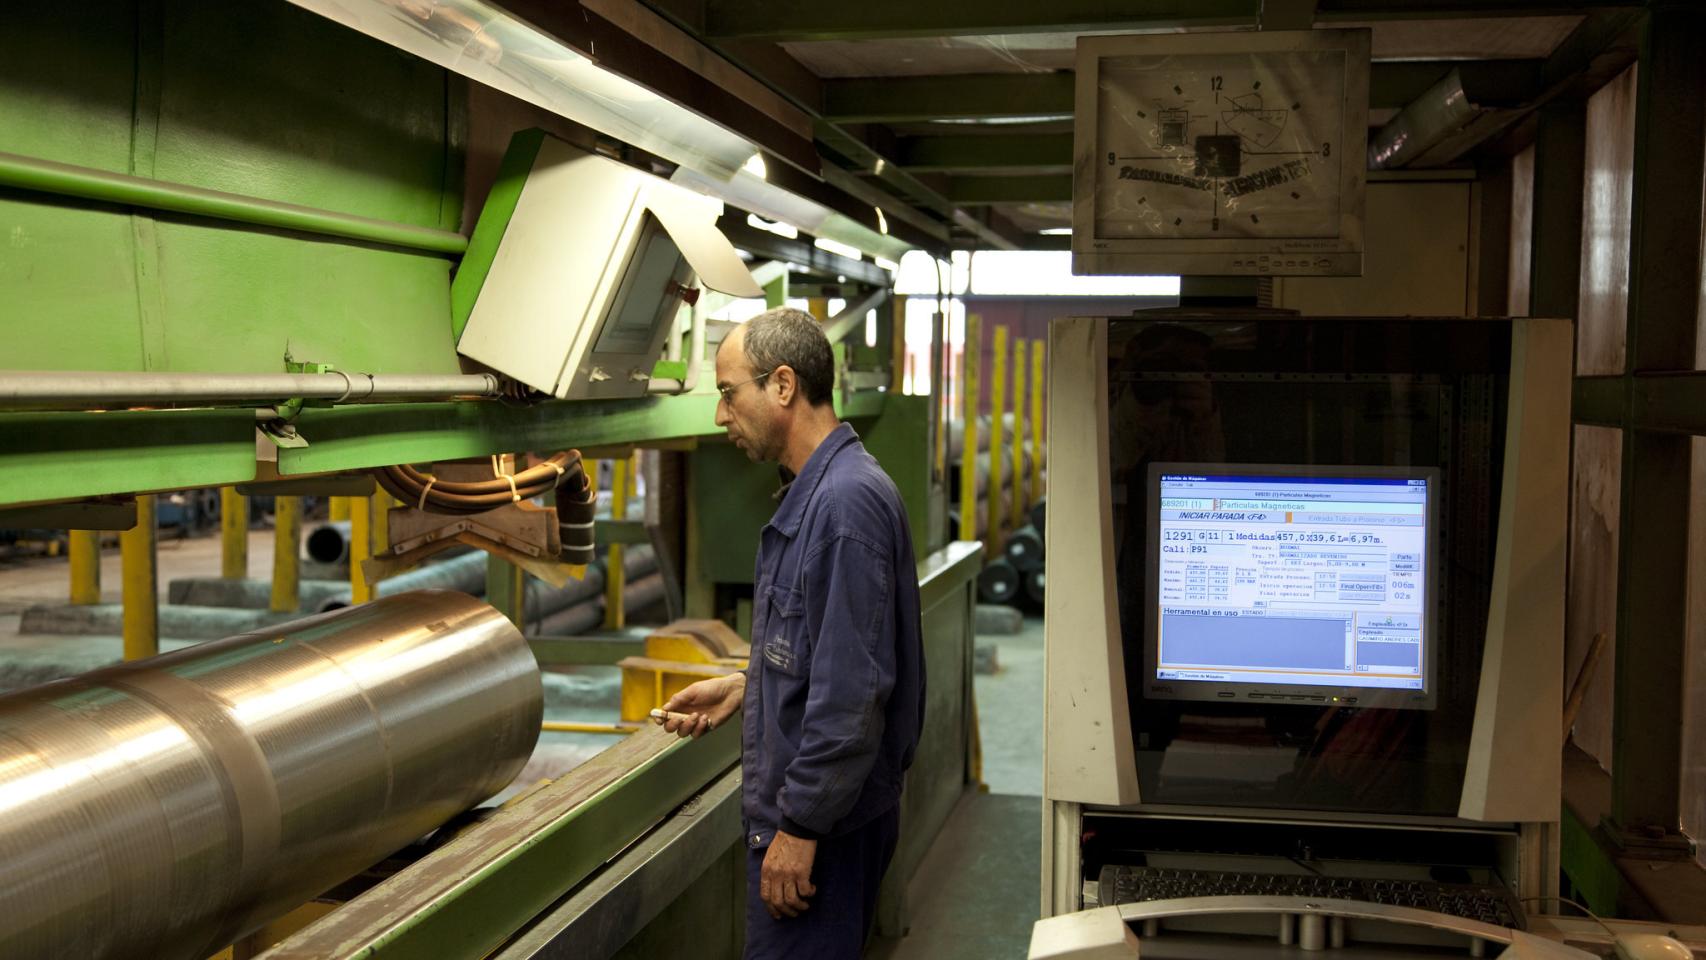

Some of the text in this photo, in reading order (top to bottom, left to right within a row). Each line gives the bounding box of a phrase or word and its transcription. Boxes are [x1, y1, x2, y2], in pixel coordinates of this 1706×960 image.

[1211, 76, 1223, 91] 12
[1322, 142, 1331, 157] 3
[1107, 152, 1116, 166] 9
[1161, 500, 1305, 512] 689201 (1) Particulas Magneticas
[1178, 511, 1267, 521] INICIAR PARADA <F4>
[1165, 531, 1193, 541] 1291
[1198, 532, 1205, 540] G
[1208, 532, 1220, 540] 11
[1236, 532, 1275, 541] Medidas
[1191, 545, 1207, 553] P91
[1163, 607, 1211, 617] Herramental
[1212, 609, 1222, 617] en
